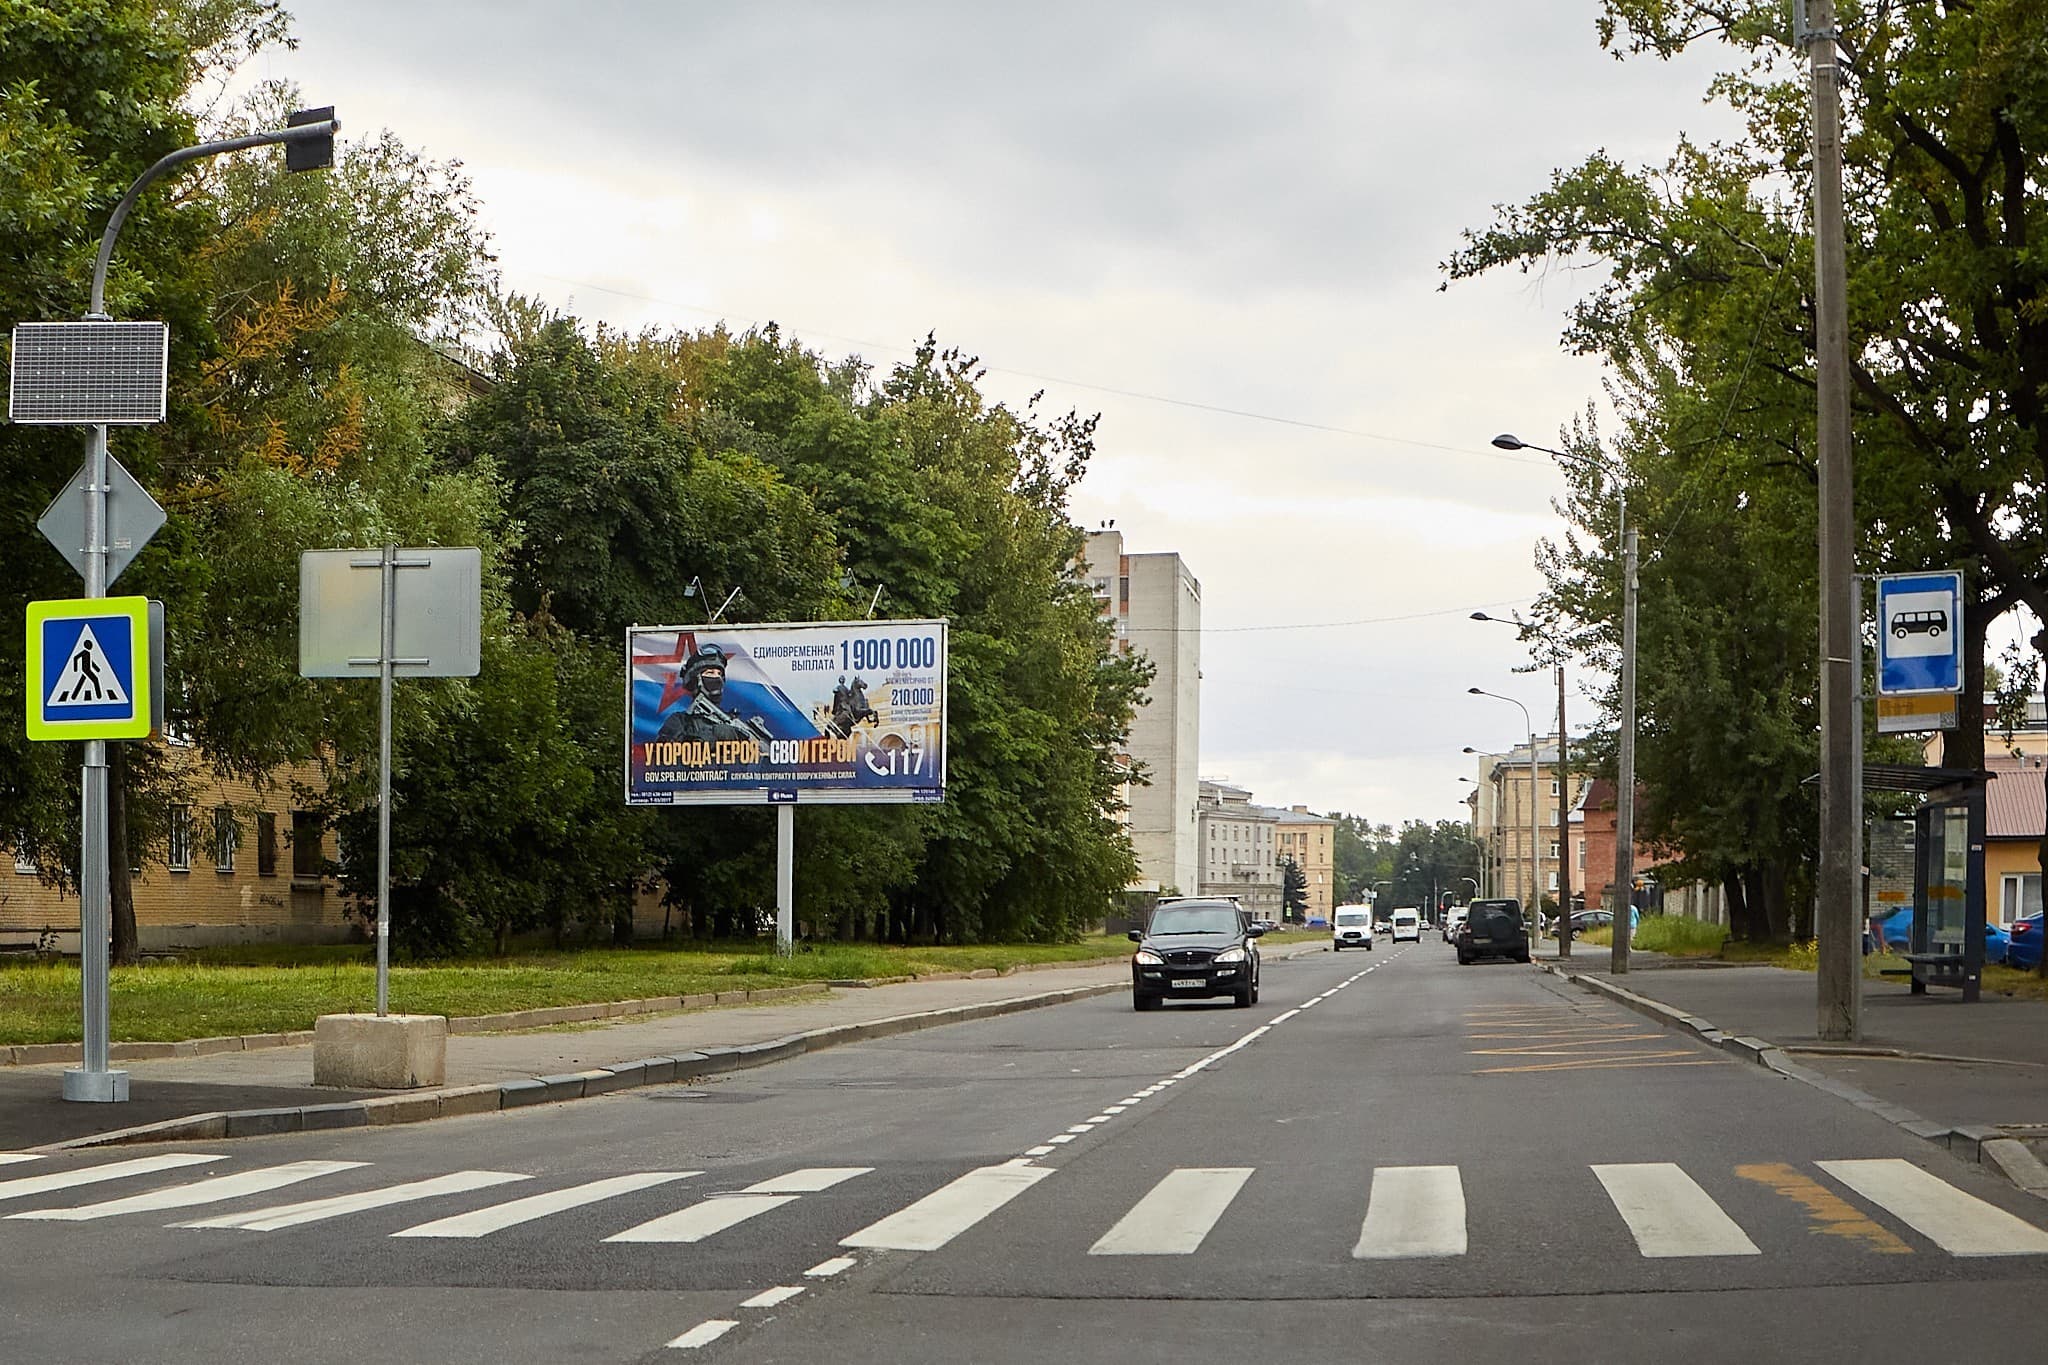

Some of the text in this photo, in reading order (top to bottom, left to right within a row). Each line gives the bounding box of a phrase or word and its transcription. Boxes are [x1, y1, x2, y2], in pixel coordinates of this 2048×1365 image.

[753, 645, 835, 659] ЕДИНОВРЕМЕННАЯ
[854, 638, 891, 670] 900
[896, 637, 935, 669] 000
[791, 659, 835, 672] ВЫПЛАТА
[891, 688, 934, 706] 210 000
[645, 742, 654, 766] У
[656, 740, 760, 768] ГОРОДА-ГЕРОЯ
[770, 740, 808, 764] СВОИ
[812, 739, 856, 763] ГЕРОИ
[888, 748, 925, 775] 117
[645, 771, 727, 783] GOV.SPB.RU/CONTRACT
[730, 772, 753, 781] СЛУЖБА
